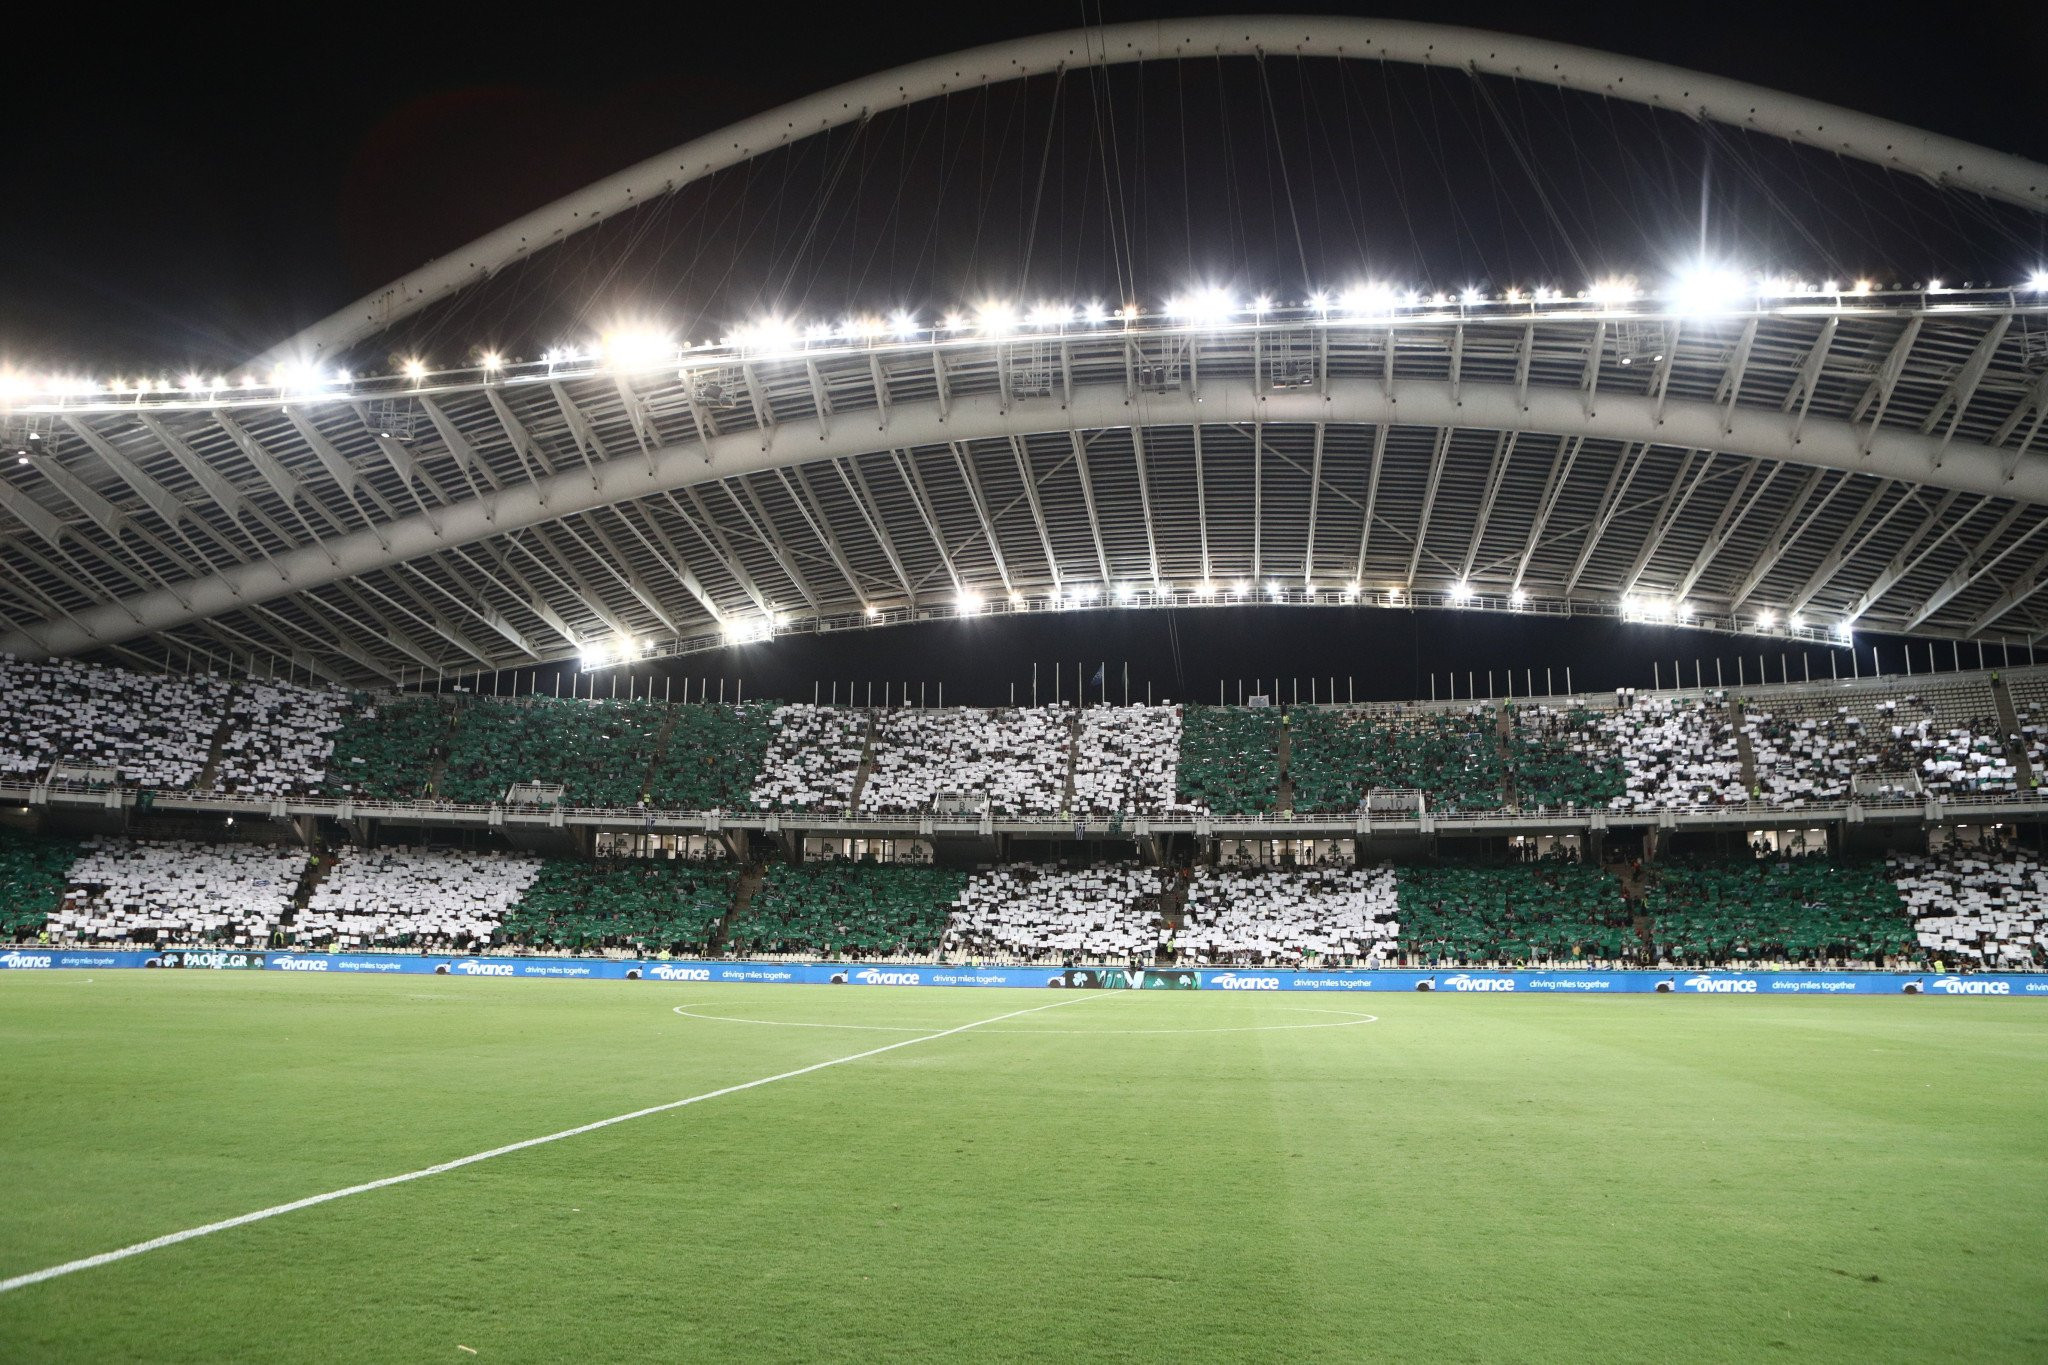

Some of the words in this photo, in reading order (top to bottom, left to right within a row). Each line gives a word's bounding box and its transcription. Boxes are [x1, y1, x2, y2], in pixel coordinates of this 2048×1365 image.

[8, 955, 51, 968] avance
[61, 957, 79, 966] driving
[80, 957, 94, 965] miles
[94, 957, 115, 966] together
[184, 954, 247, 967] PAOFC.GR
[282, 959, 328, 971] avance
[339, 961, 358, 970] driving
[358, 961, 374, 969] miles
[374, 962, 401, 971] together
[467, 964, 513, 975] avance
[525, 966, 546, 975] driving
[547, 966, 563, 974] miles
[563, 967, 590, 975] together
[660, 968, 710, 981] avance
[722, 971, 745, 980] driving
[745, 971, 762, 979] miles
[763, 972, 791, 980] together
[867, 972, 919, 985] avance
[933, 975, 957, 984] driving
[957, 975, 975, 983] miles
[976, 975, 1006, 984] together
[1222, 977, 1279, 990] avance
[1294, 978, 1318, 988] driving
[1339, 979, 1371, 988] together
[1456, 978, 1515, 991] avance
[1529, 980, 1555, 989] driving
[1556, 980, 1576, 988] miles
[1577, 980, 1610, 989] together
[1697, 978, 1757, 993] avance
[1772, 981, 1800, 991] driving
[1800, 981, 1821, 989] miles
[1821, 981, 1856, 991] together
[1946, 979, 2010, 994] avance
